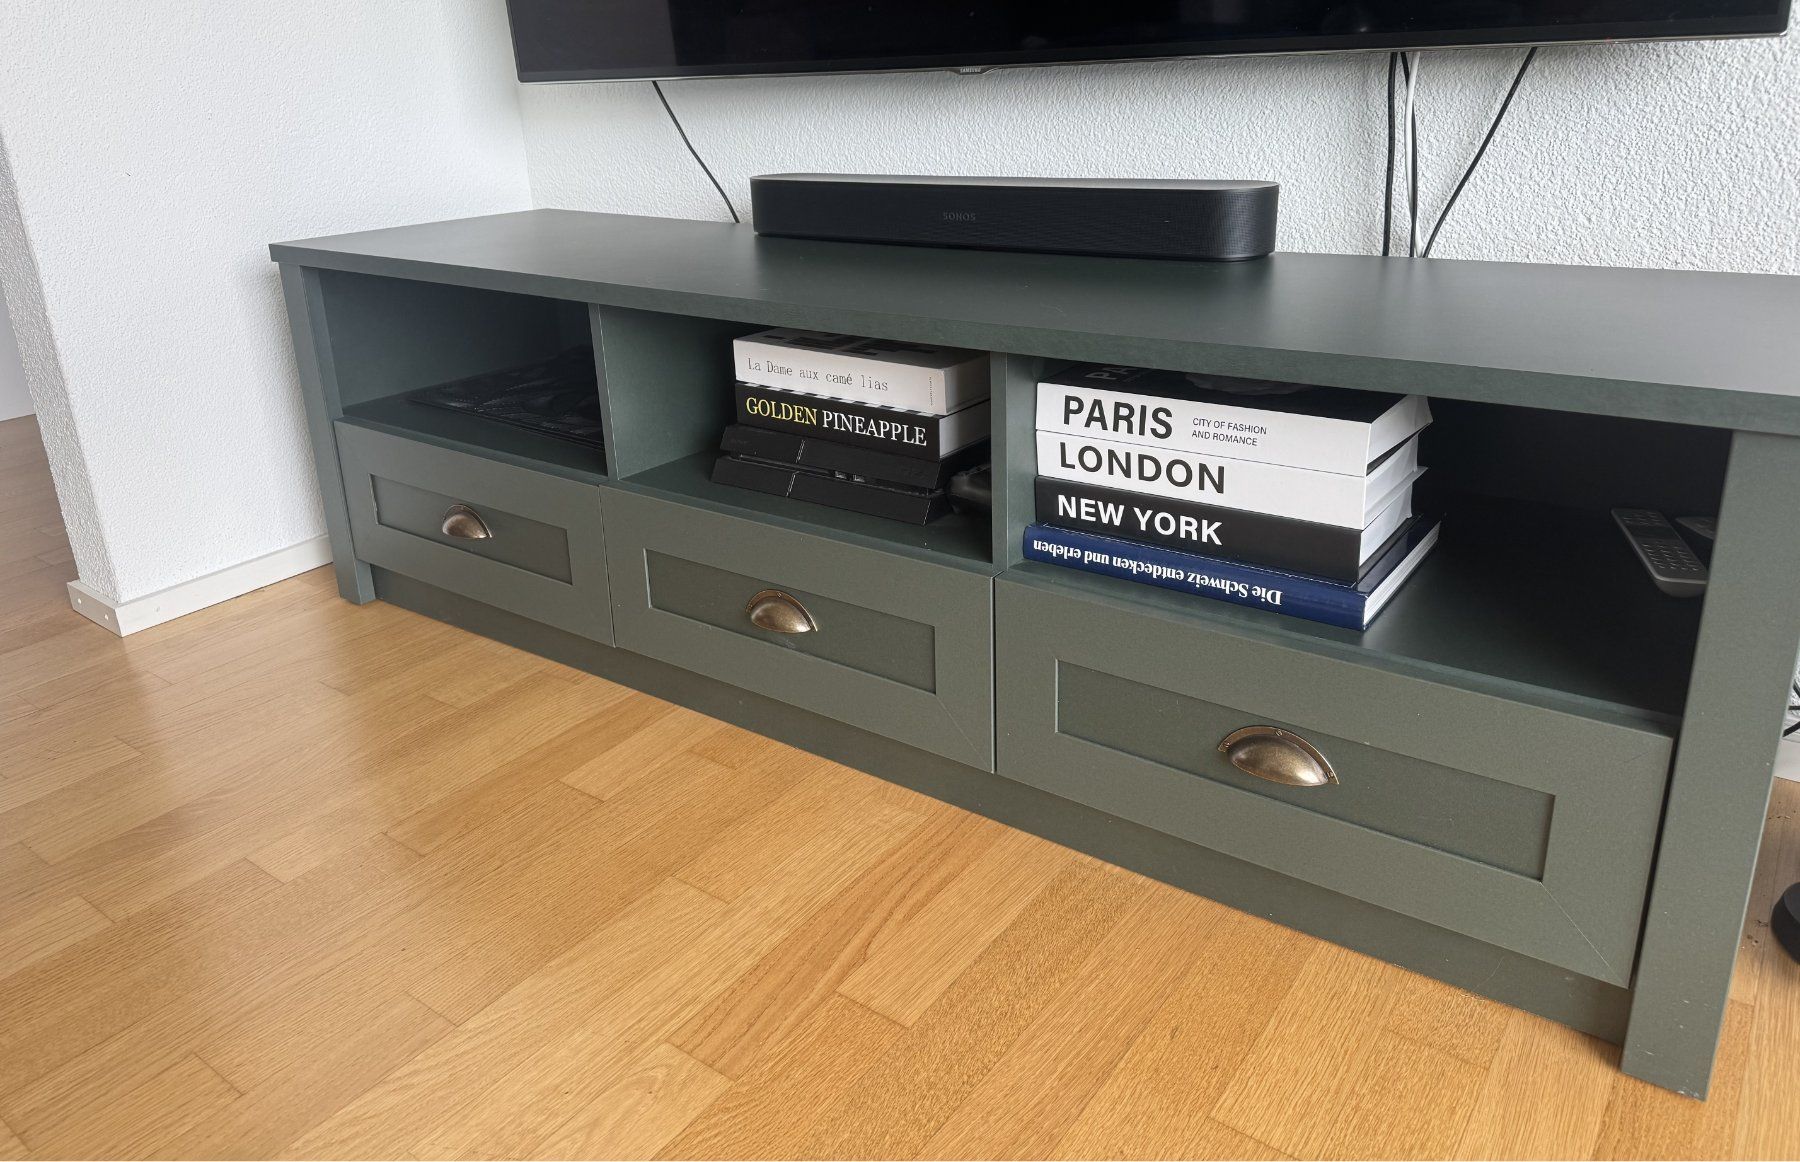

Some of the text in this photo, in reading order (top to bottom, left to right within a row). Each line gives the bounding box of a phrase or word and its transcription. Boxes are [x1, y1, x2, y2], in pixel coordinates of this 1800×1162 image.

[943, 211, 976, 221] SONOS
[748, 358, 889, 392] La Dame aux camé lias
[746, 397, 927, 446] GOLDEN PINEAPPLE
[1063, 395, 1173, 440] PARIS
[1191, 430, 1258, 446] AND ROMANCE
[1192, 417, 1267, 435] CITY OF FASHION
[1060, 442, 1225, 494] LONDON
[1058, 494, 1223, 546] NEW YORK
[1033, 540, 1282, 606] Die Schweiz entdecken und erleben
